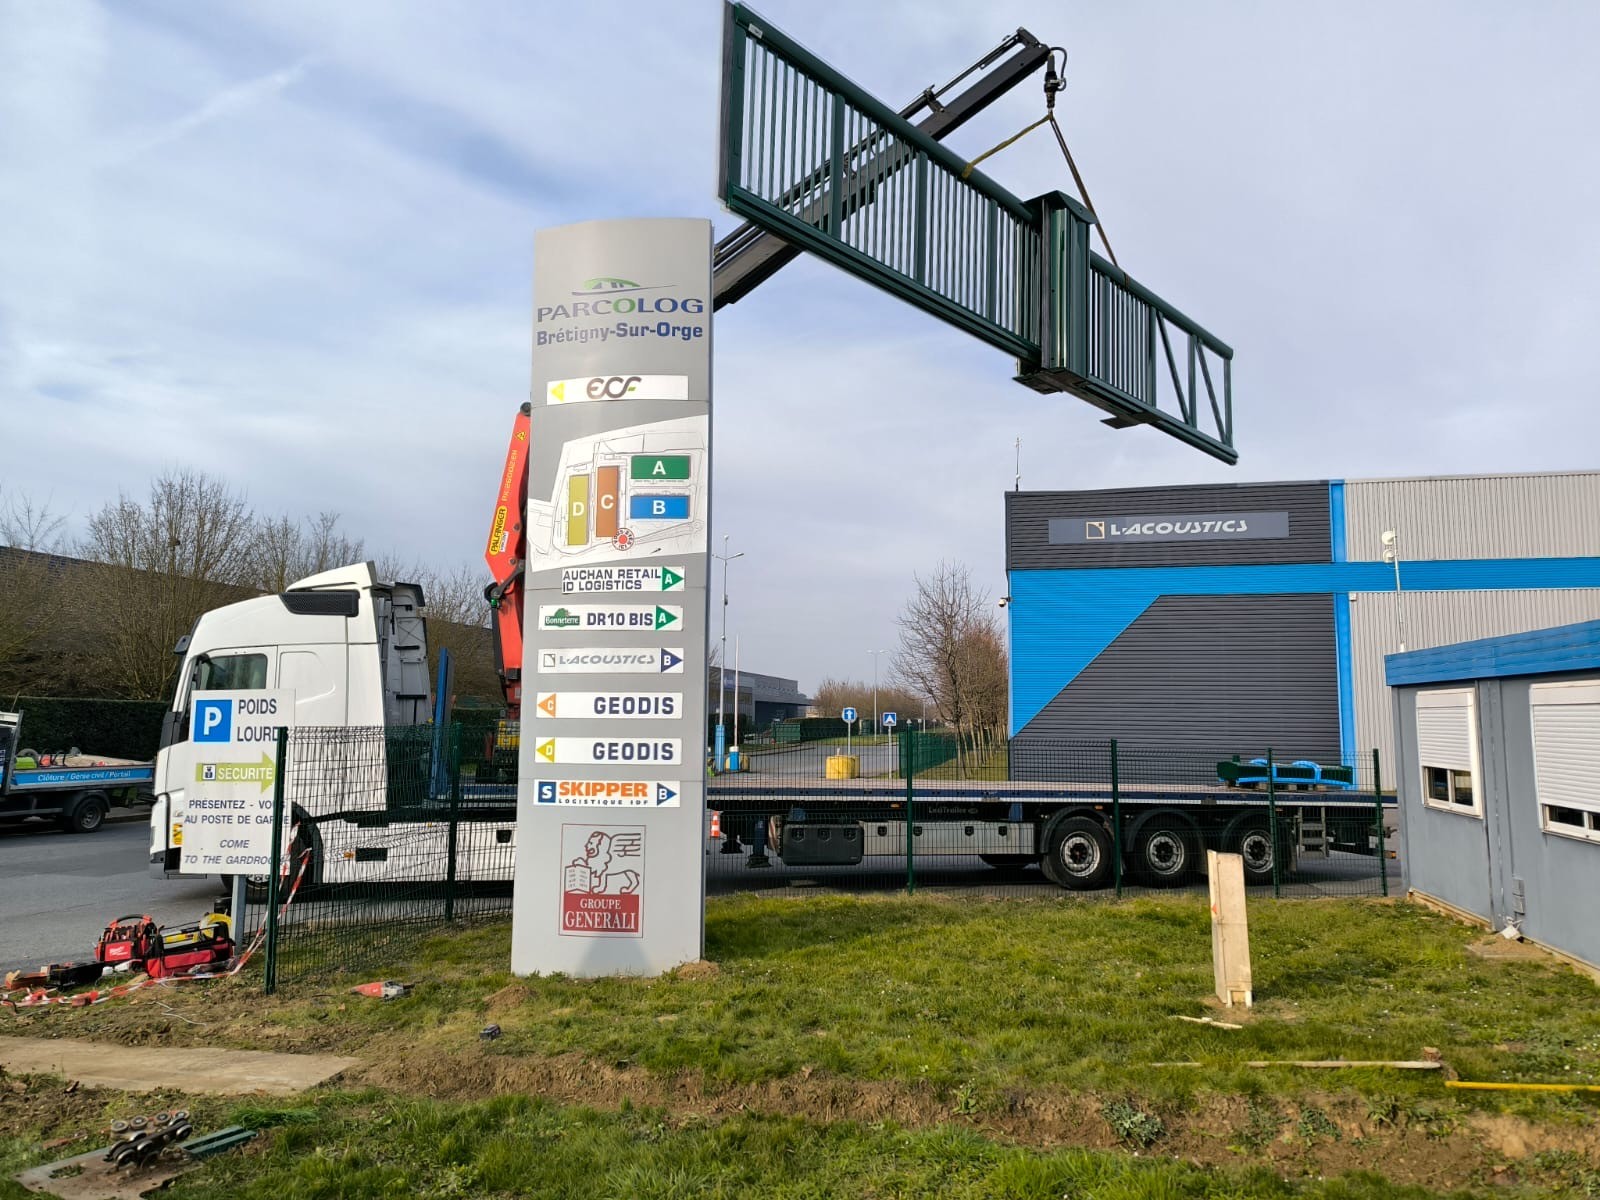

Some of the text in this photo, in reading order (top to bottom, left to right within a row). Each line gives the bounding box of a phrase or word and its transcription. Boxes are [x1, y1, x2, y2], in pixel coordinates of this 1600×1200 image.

[537, 297, 704, 323] PARCOLOG
[537, 321, 703, 346] Brétigny-Sur-Orge
[586, 376, 642, 400] ECF
[652, 460, 667, 475] A
[572, 502, 585, 517] D
[600, 494, 614, 510] C
[652, 500, 666, 515] B
[490, 507, 506, 552] PALFINGER
[562, 568, 662, 581] AUCHAN RETAIL
[664, 573, 673, 584] A
[563, 580, 642, 593] ID LOGISTICS
[545, 615, 579, 625] Bonneterre
[587, 612, 653, 626] DR10 BIS
[658, 613, 667, 624] A
[663, 655, 671, 666] B
[238, 698, 277, 715] POIDS
[547, 698, 554, 711] C
[593, 696, 674, 715] GEODIS
[203, 707, 223, 736] P
[236, 726, 283, 742] LOURD
[546, 745, 553, 756] D
[592, 742, 674, 761] GEODIS
[541, 785, 553, 800] S
[558, 781, 649, 798] SKIPPER
[658, 788, 668, 801] B
[558, 798, 623, 806] LOGISTIQUE
[184, 815, 291, 825] AU POSTE DE GARE
[219, 839, 251, 849] COME
[184, 855, 198, 865] TO
[202, 855, 222, 865] THE
[579, 898, 622, 910] GROUPE
[564, 910, 637, 930] GENERALI
